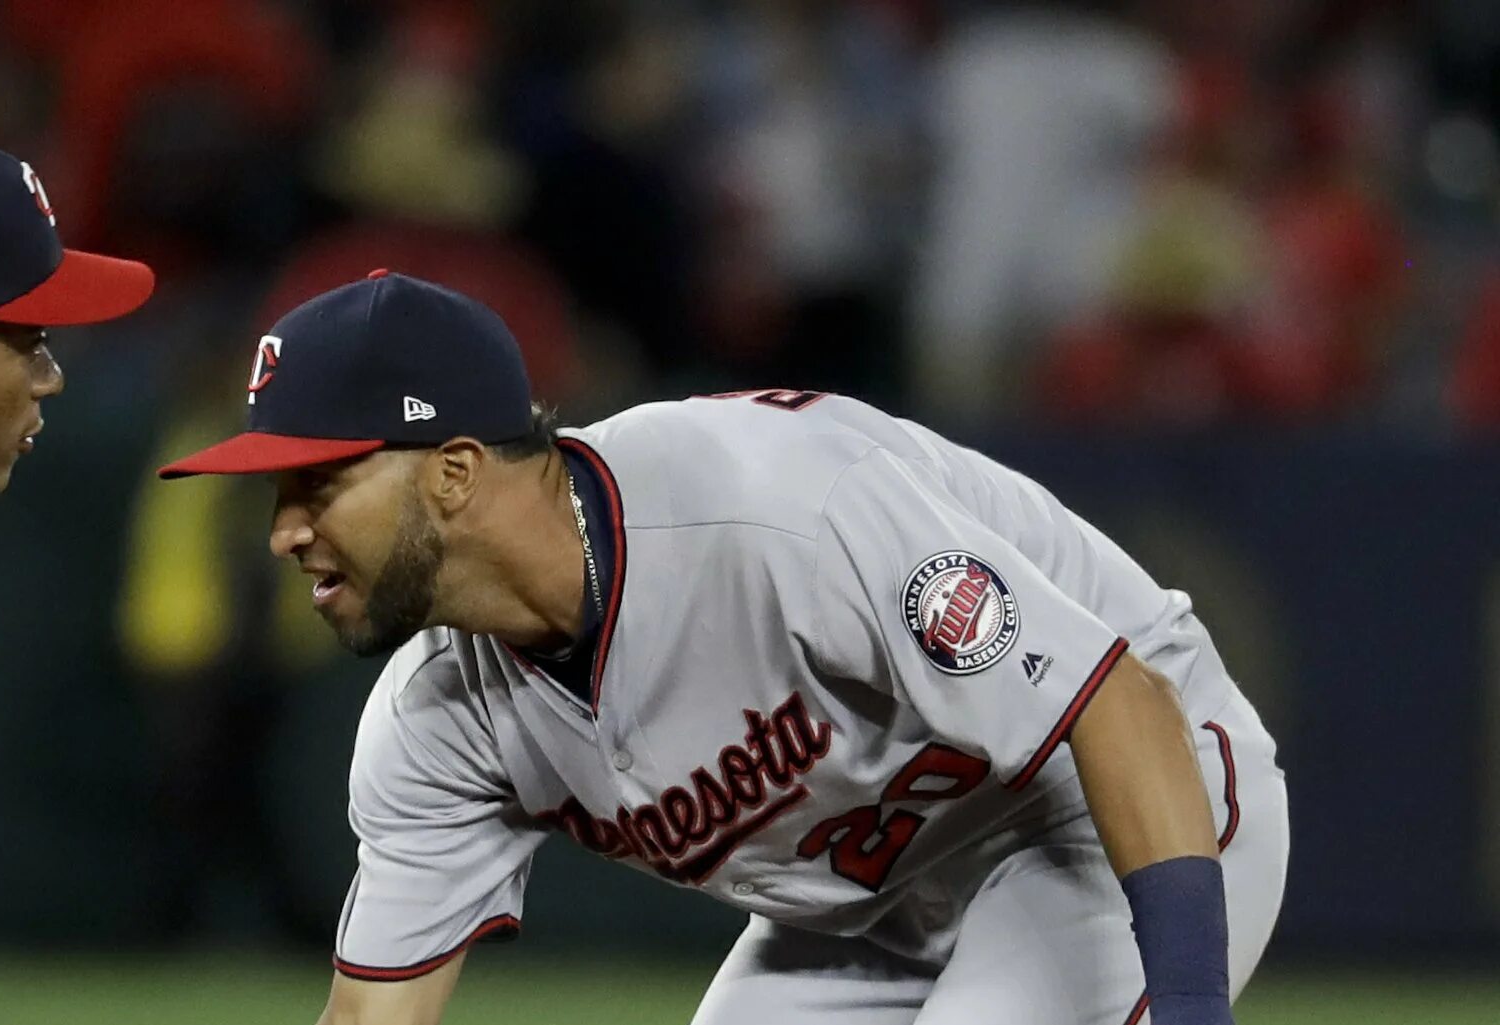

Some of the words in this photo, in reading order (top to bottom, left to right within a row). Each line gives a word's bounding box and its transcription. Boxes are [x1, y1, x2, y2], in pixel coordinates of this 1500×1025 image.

[905, 555, 969, 632] MINNESOTA
[924, 562, 992, 661] Twins
[956, 629, 1013, 669] BASEBALL
[1002, 593, 1016, 626] CLUB
[796, 741, 992, 894] 20
